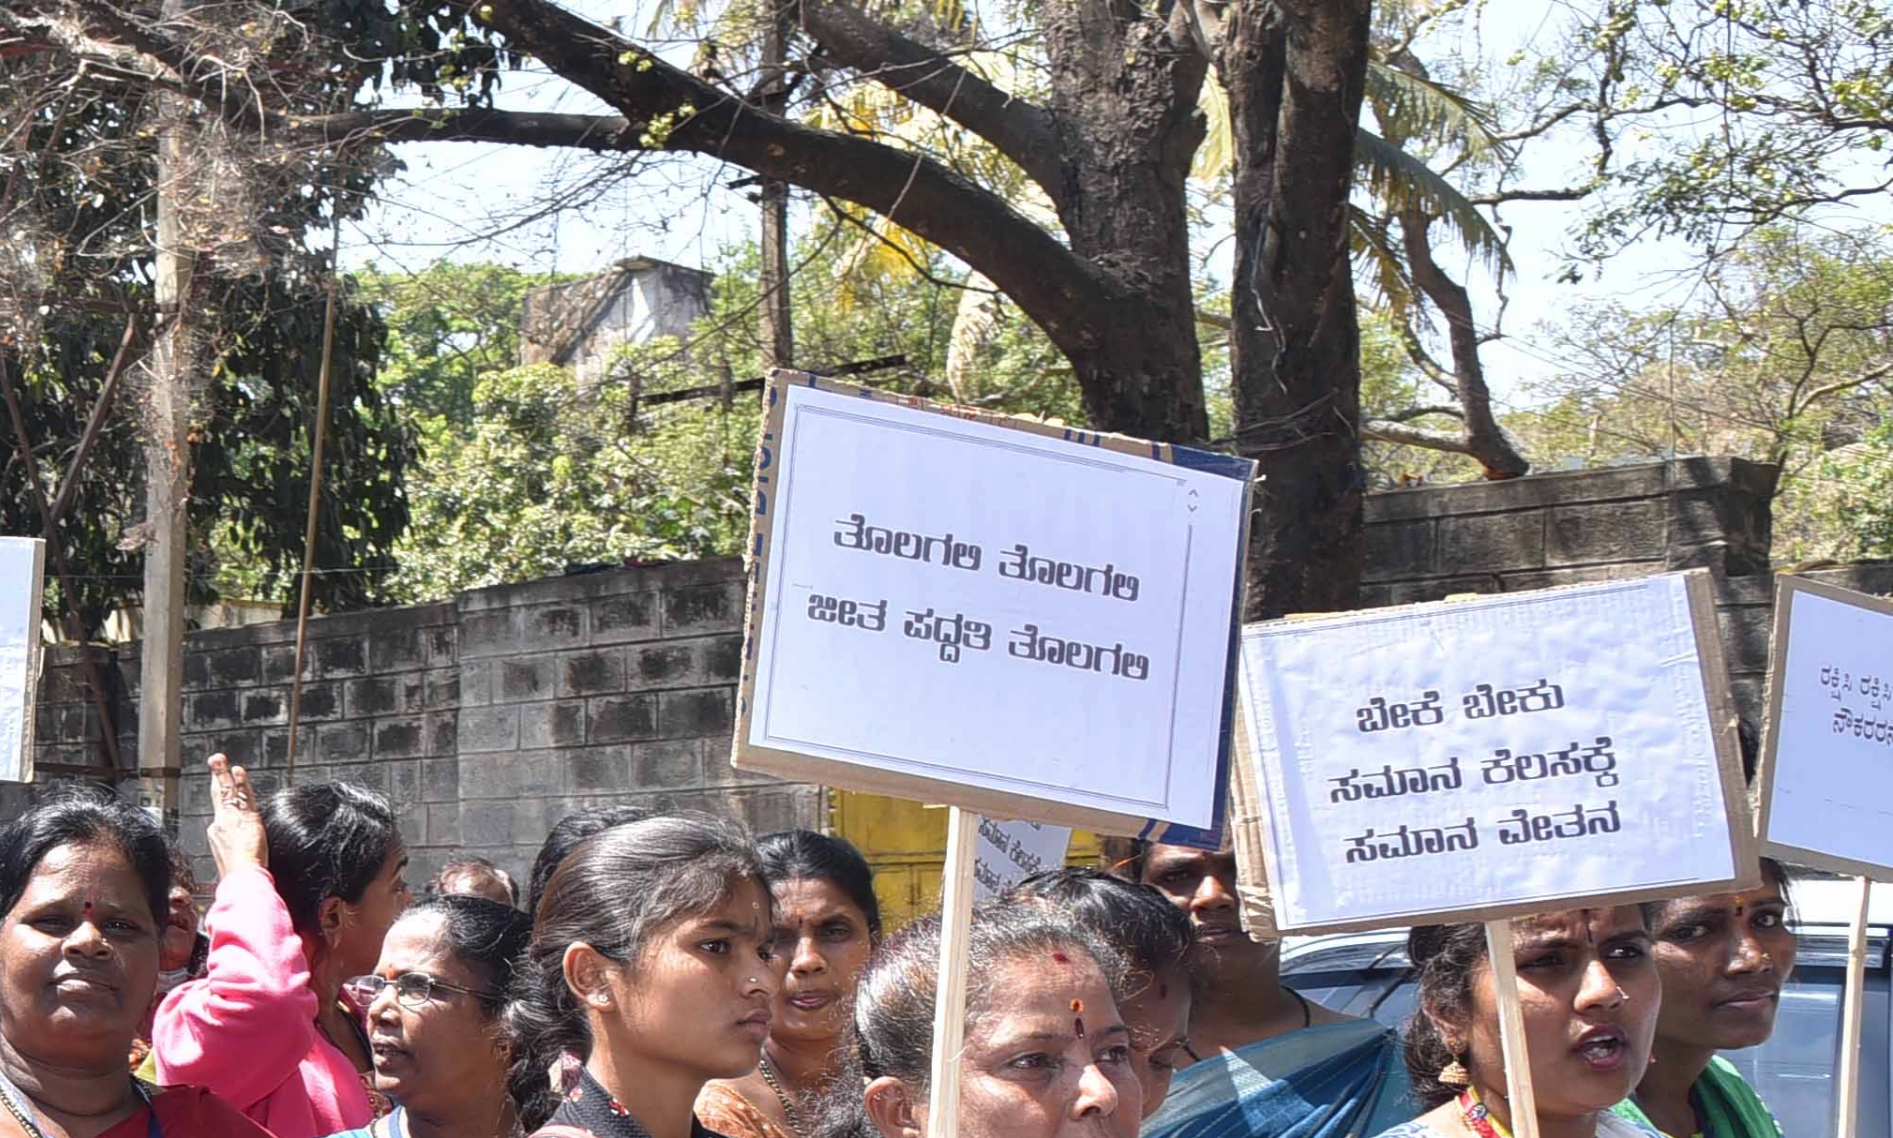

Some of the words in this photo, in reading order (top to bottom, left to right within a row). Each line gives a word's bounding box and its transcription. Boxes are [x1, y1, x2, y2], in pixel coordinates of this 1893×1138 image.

[833, 513, 982, 571] ತೊಲಗಲಿ
[998, 544, 1140, 602] ತೊಲಗಲಿ
[808, 594, 887, 632] ಜೀತ
[1008, 624, 1150, 681] ತೊಲಗಲಿ
[1356, 690, 1444, 733] ಬೇಕೆ
[1463, 678, 1565, 720] ಬೇಕು
[1328, 756, 1463, 803] ಸಮಾನ
[1481, 736, 1620, 788] ಕೆಲಸಕ್ಕೆ
[1343, 817, 1479, 864] ಸಮಾನ
[1497, 800, 1622, 846] ವೇತನ
